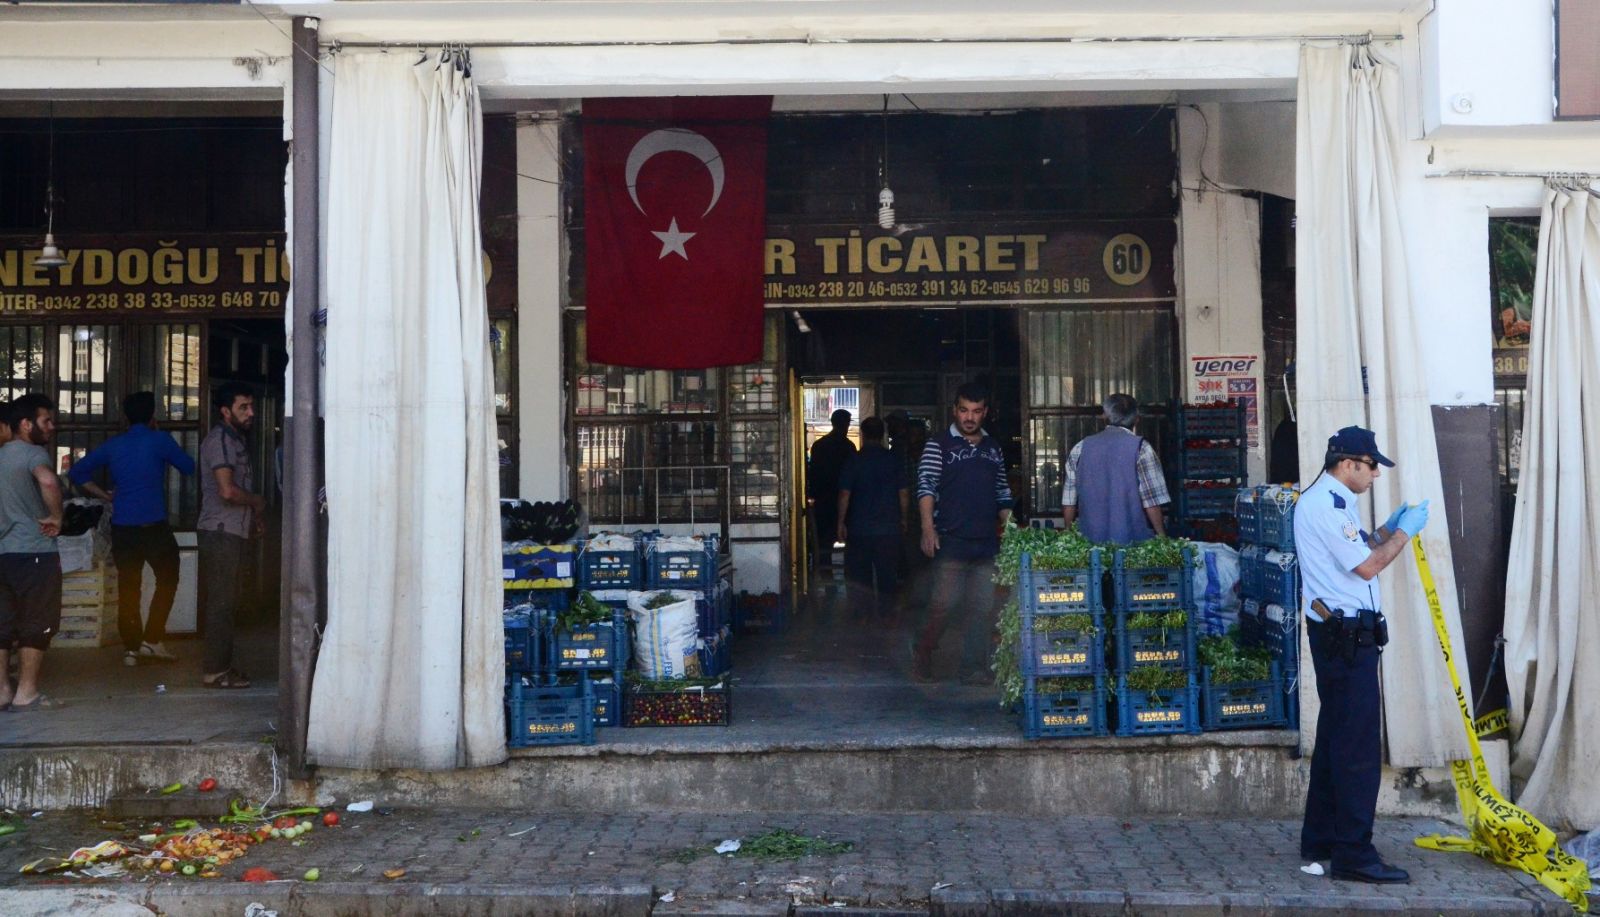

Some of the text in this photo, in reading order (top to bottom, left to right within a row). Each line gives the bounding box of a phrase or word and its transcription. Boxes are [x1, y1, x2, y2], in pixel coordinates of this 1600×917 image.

[815, 230, 1047, 274] TİCARET
[1112, 243, 1143, 275] 60
[818, 281, 844, 298] 238
[847, 281, 865, 297] 20
[921, 280, 946, 296] 391
[950, 280, 967, 296] 34
[1024, 278, 1049, 294] 629
[1053, 277, 1070, 294] 96
[1073, 277, 1090, 293] 96
[85, 292, 119, 309] 238
[123, 292, 146, 309] 38
[221, 291, 253, 308] 648
[258, 290, 280, 307] 70
[1194, 359, 1256, 377] yener
[1494, 356, 1514, 373] 38
